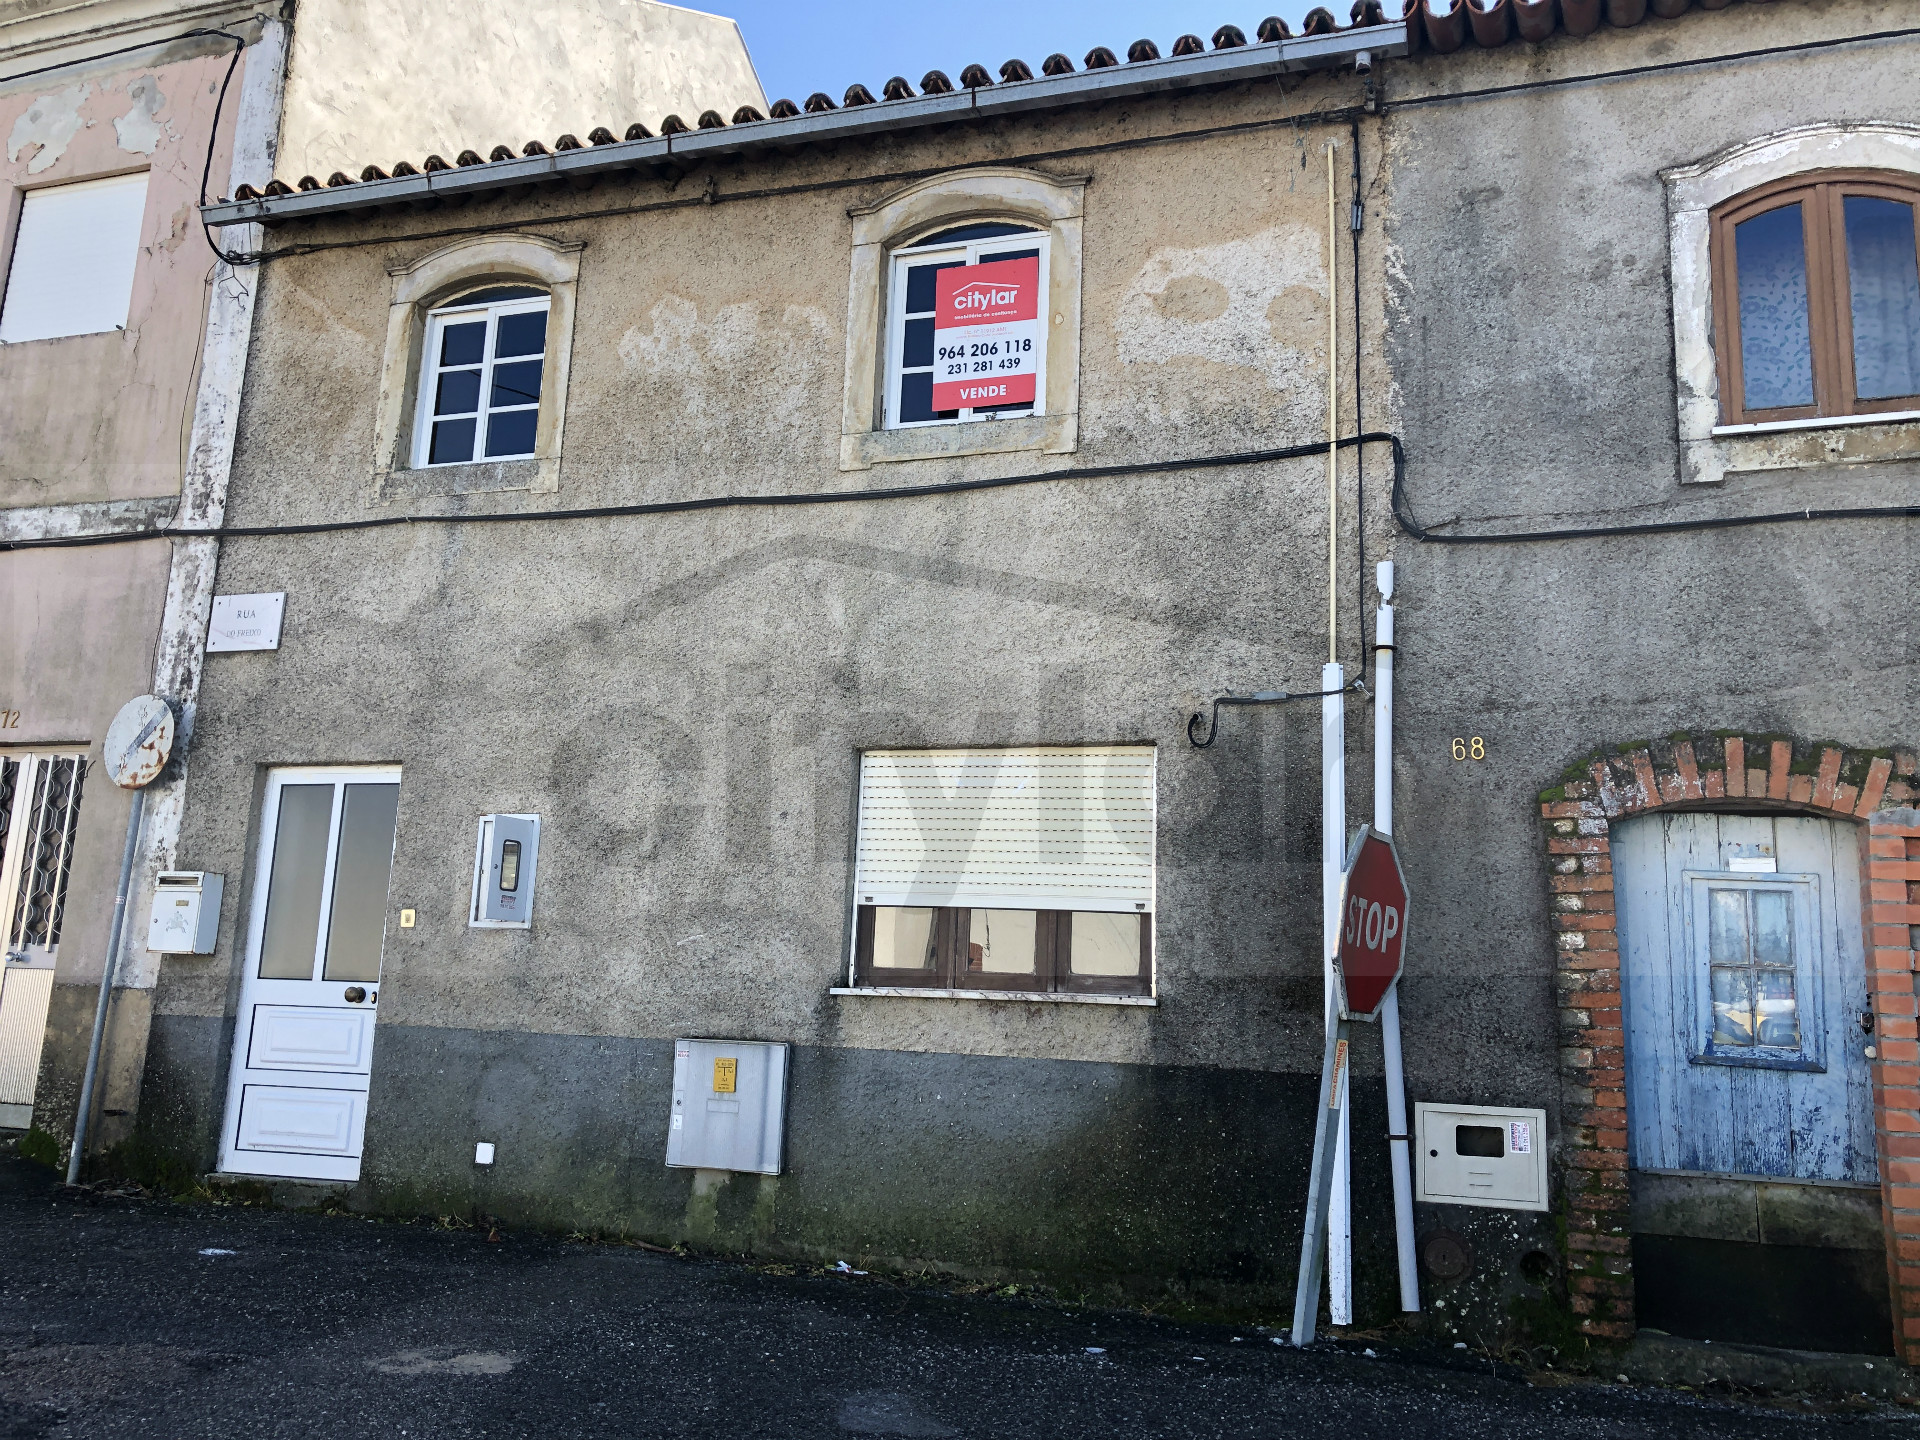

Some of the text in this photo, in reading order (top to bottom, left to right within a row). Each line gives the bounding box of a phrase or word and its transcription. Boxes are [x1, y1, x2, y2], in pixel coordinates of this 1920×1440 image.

[954, 289, 1018, 311] citylar
[938, 338, 1032, 361] 964 206 118
[947, 357, 1021, 375] 231 281 439
[960, 384, 1007, 400] VENDE
[237, 609, 256, 619] RUA
[1, 709, 20, 729] 72
[1452, 736, 1485, 761] 68
[1346, 894, 1399, 954] STOP
